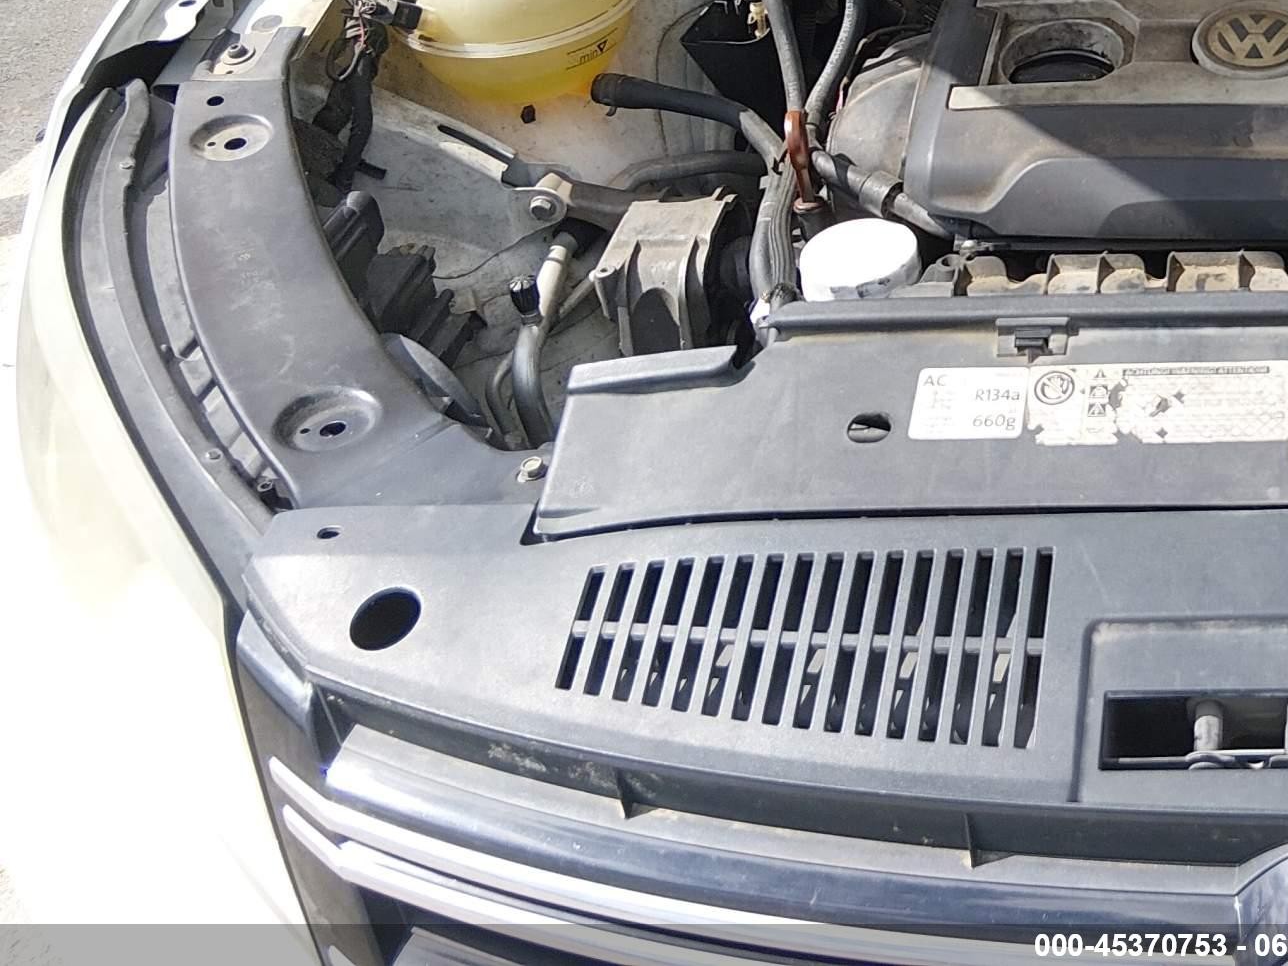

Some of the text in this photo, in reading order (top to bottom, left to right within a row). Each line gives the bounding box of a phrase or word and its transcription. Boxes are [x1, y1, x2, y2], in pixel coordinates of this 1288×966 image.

[579, 48, 599, 66] min
[922, 374, 948, 387] AC
[975, 388, 1020, 402] R134a
[972, 414, 1017, 431] 660g
